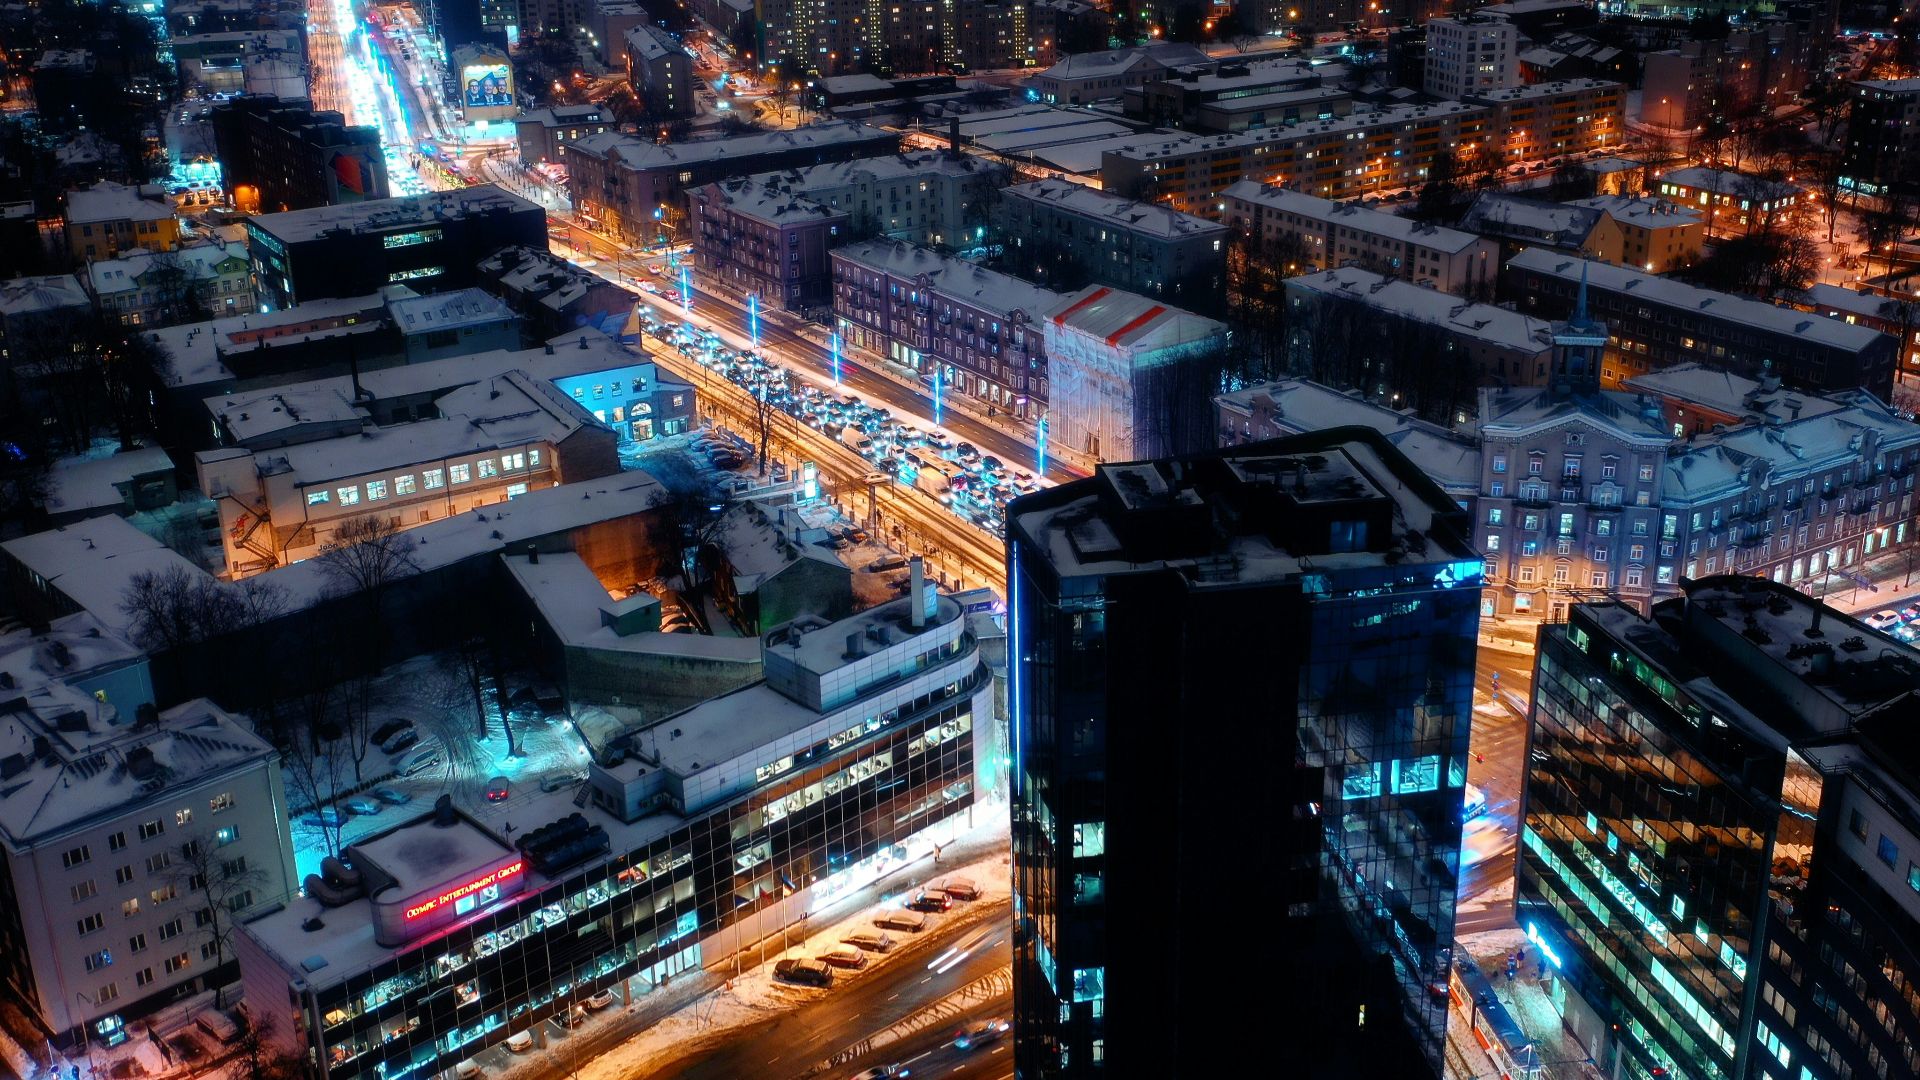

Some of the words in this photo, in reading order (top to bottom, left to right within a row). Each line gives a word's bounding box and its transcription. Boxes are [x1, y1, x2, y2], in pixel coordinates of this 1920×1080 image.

[407, 900, 437, 919] OLYMPIC
[439, 874, 496, 904] ENTERTAINMENT
[497, 862, 522, 879] GROUP
